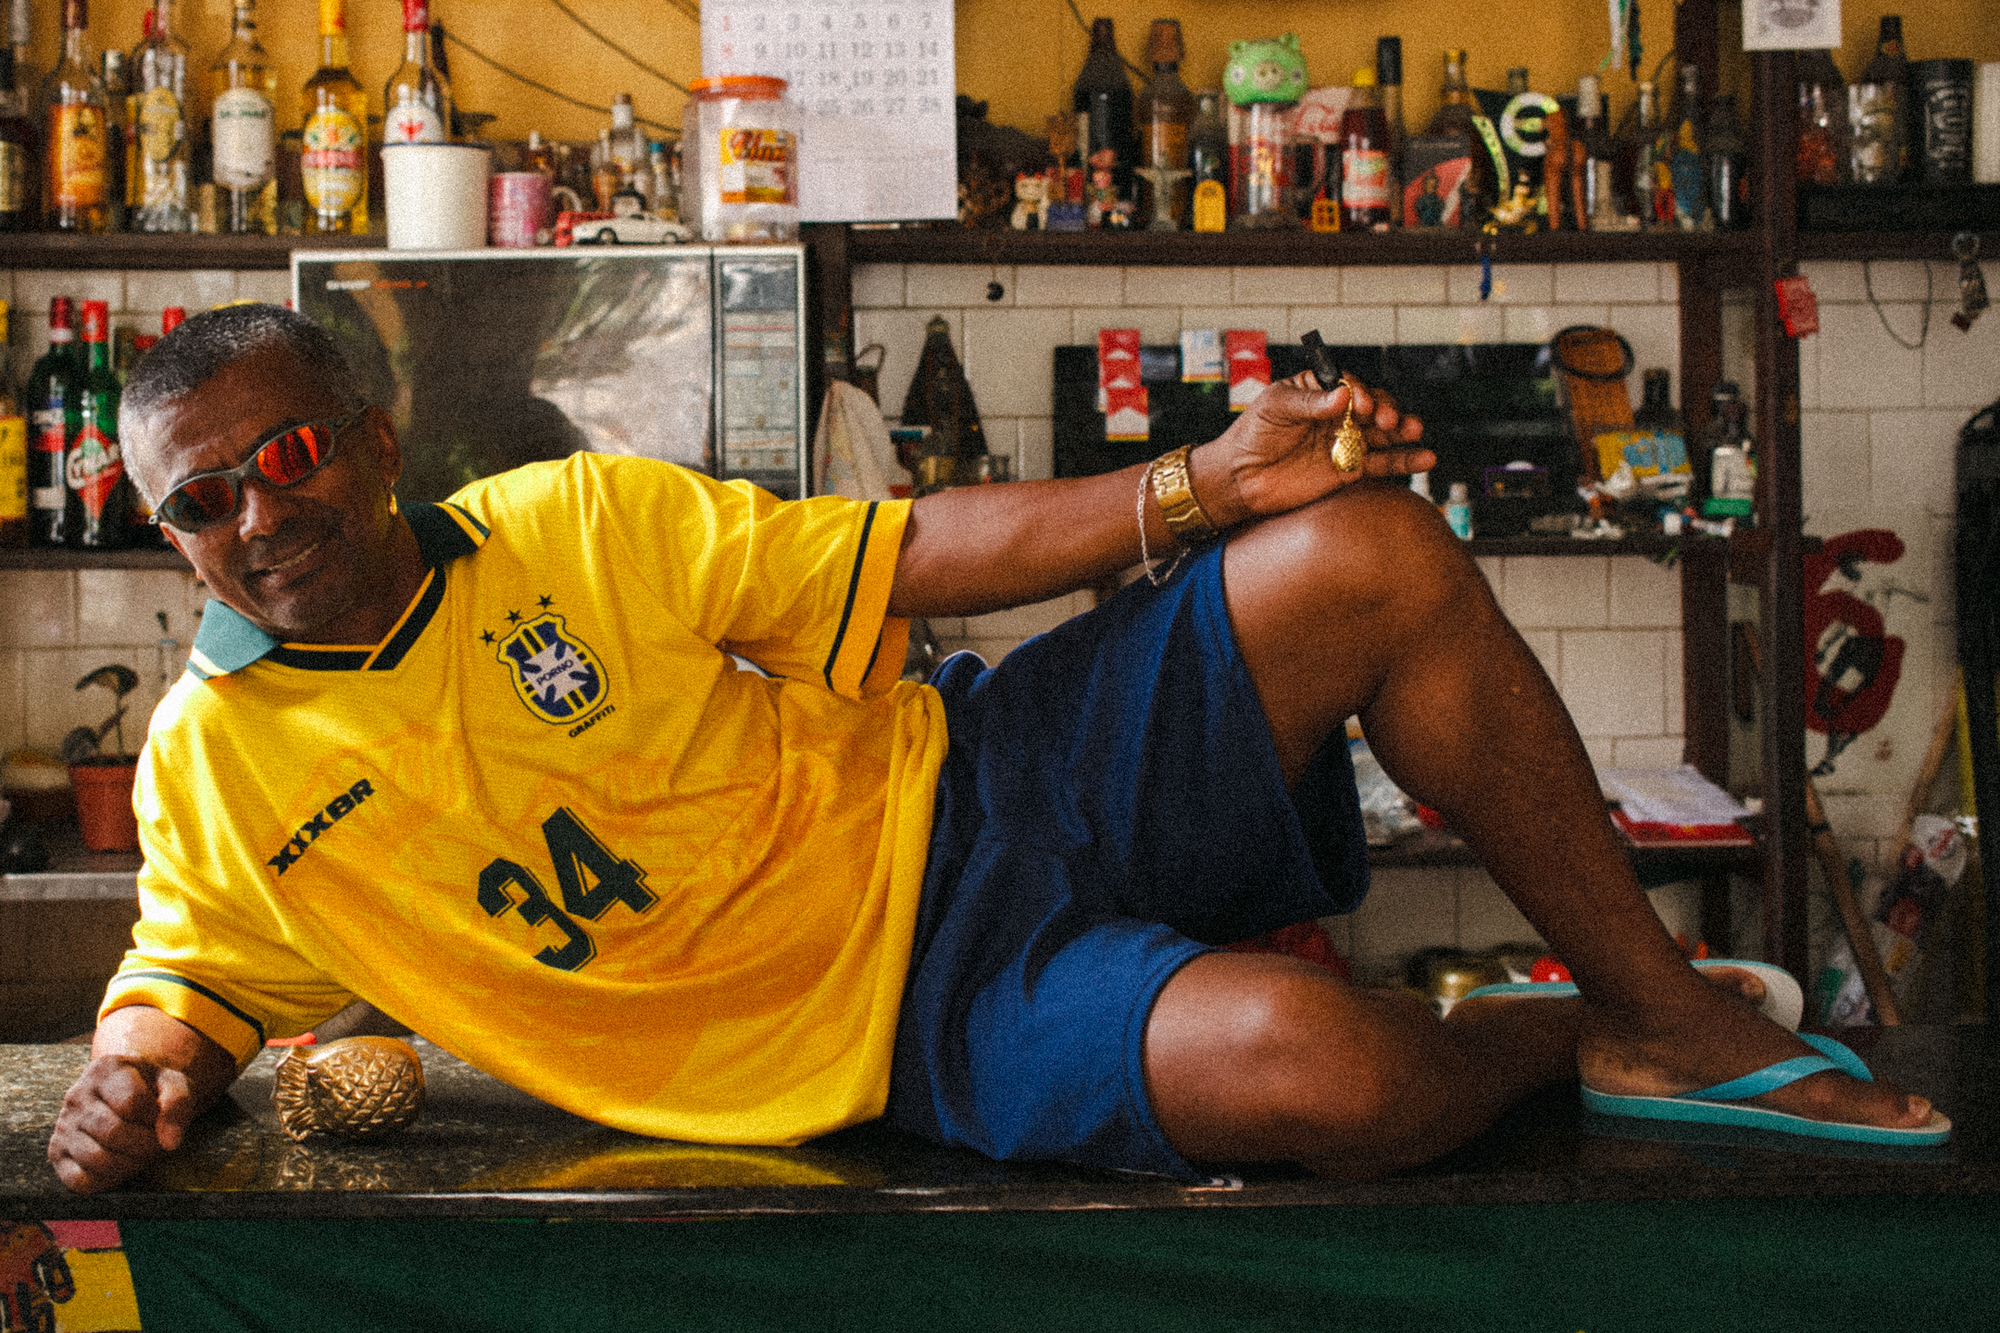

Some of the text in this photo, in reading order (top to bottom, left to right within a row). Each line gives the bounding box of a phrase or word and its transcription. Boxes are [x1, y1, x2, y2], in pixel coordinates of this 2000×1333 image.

[754, 14, 767, 32] 2
[787, 13, 801, 32] 3
[821, 14, 834, 32] 4
[853, 12, 868, 31] 5
[886, 12, 901, 31] 6
[921, 11, 932, 30] 7
[754, 41, 767, 59] 9
[785, 41, 808, 59] 10
[818, 41, 838, 60] 11
[851, 41, 874, 59] 12
[885, 41, 907, 59] 13
[918, 41, 939, 59] 14
[818, 69, 841, 88] 18
[851, 69, 874, 88] 19
[883, 68, 908, 88] 20
[917, 68, 938, 87] 21
[535, 659, 575, 686] PORNO
[568, 704, 617, 738] GRAFFITI
[476, 806, 661, 973] 34
